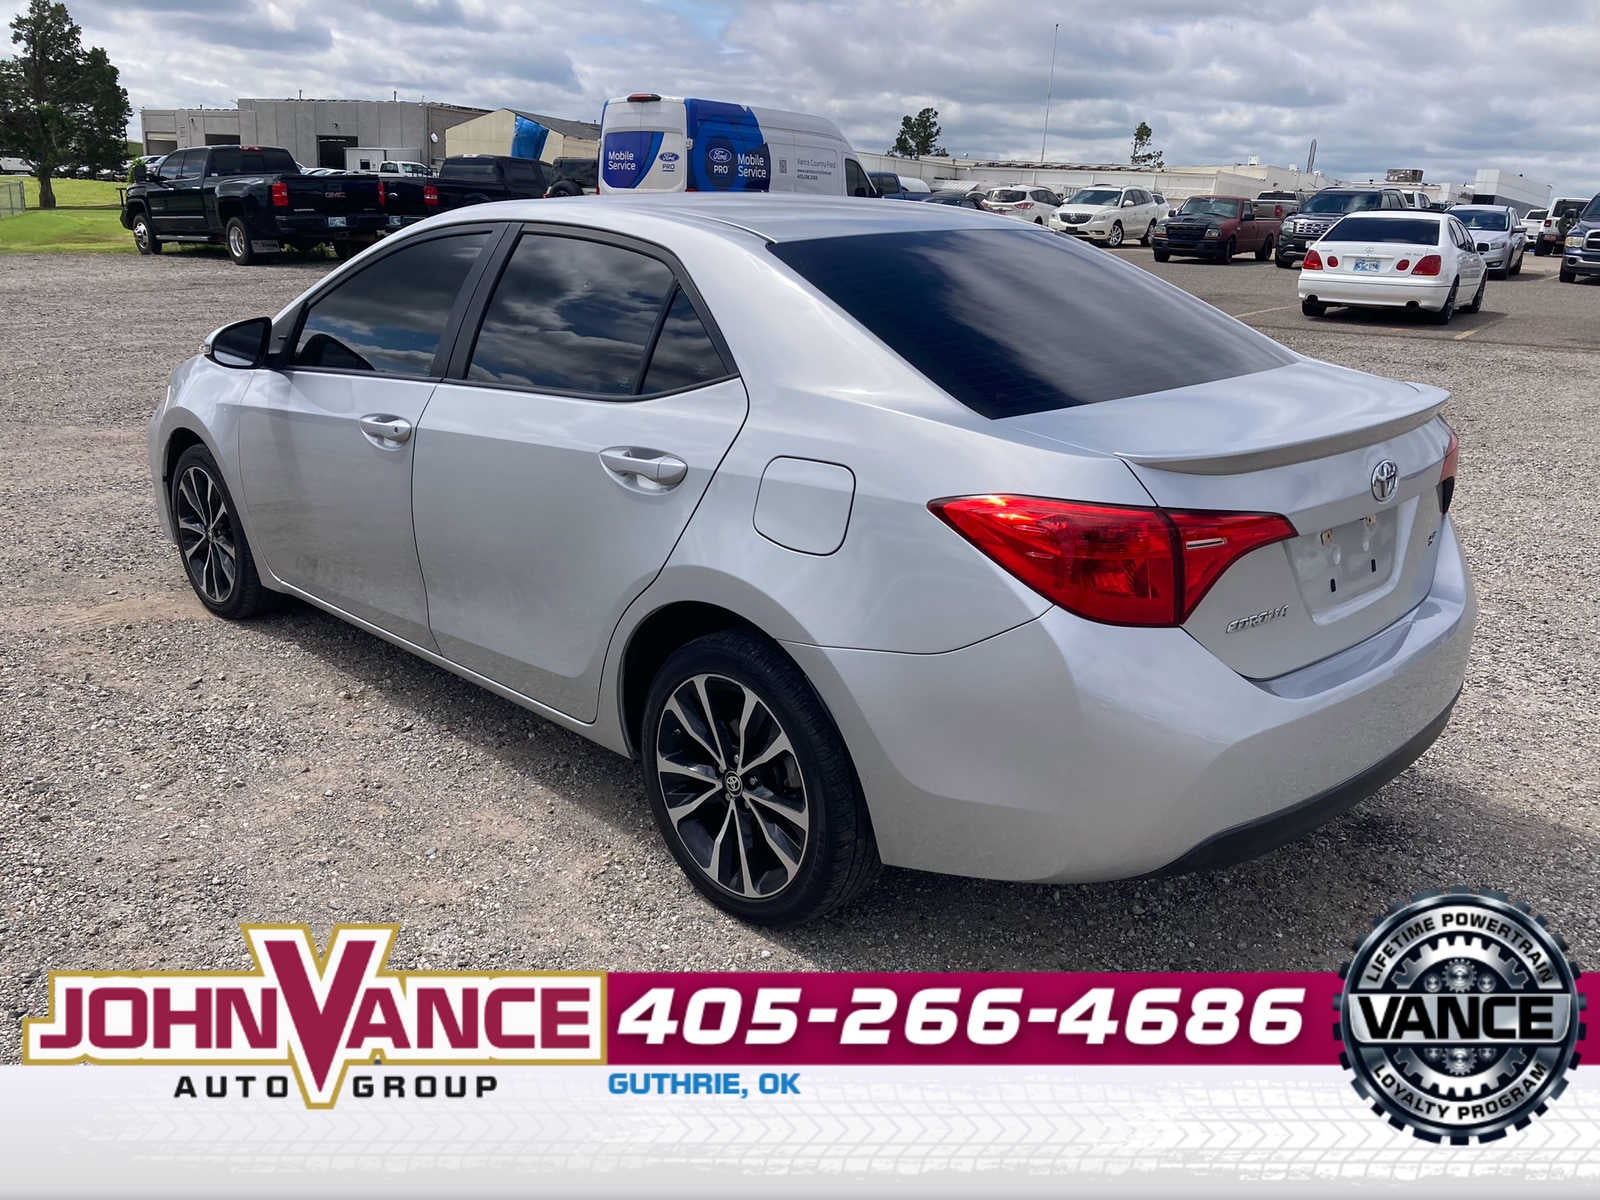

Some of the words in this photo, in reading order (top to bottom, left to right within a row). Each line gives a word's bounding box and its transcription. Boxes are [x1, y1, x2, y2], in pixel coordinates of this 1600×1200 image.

[608, 151, 634, 160] Mobile
[713, 150, 728, 160] Ford
[737, 153, 764, 166] Mobile
[608, 160, 636, 171] Service
[713, 165, 728, 174] PRO
[738, 166, 766, 178] Service
